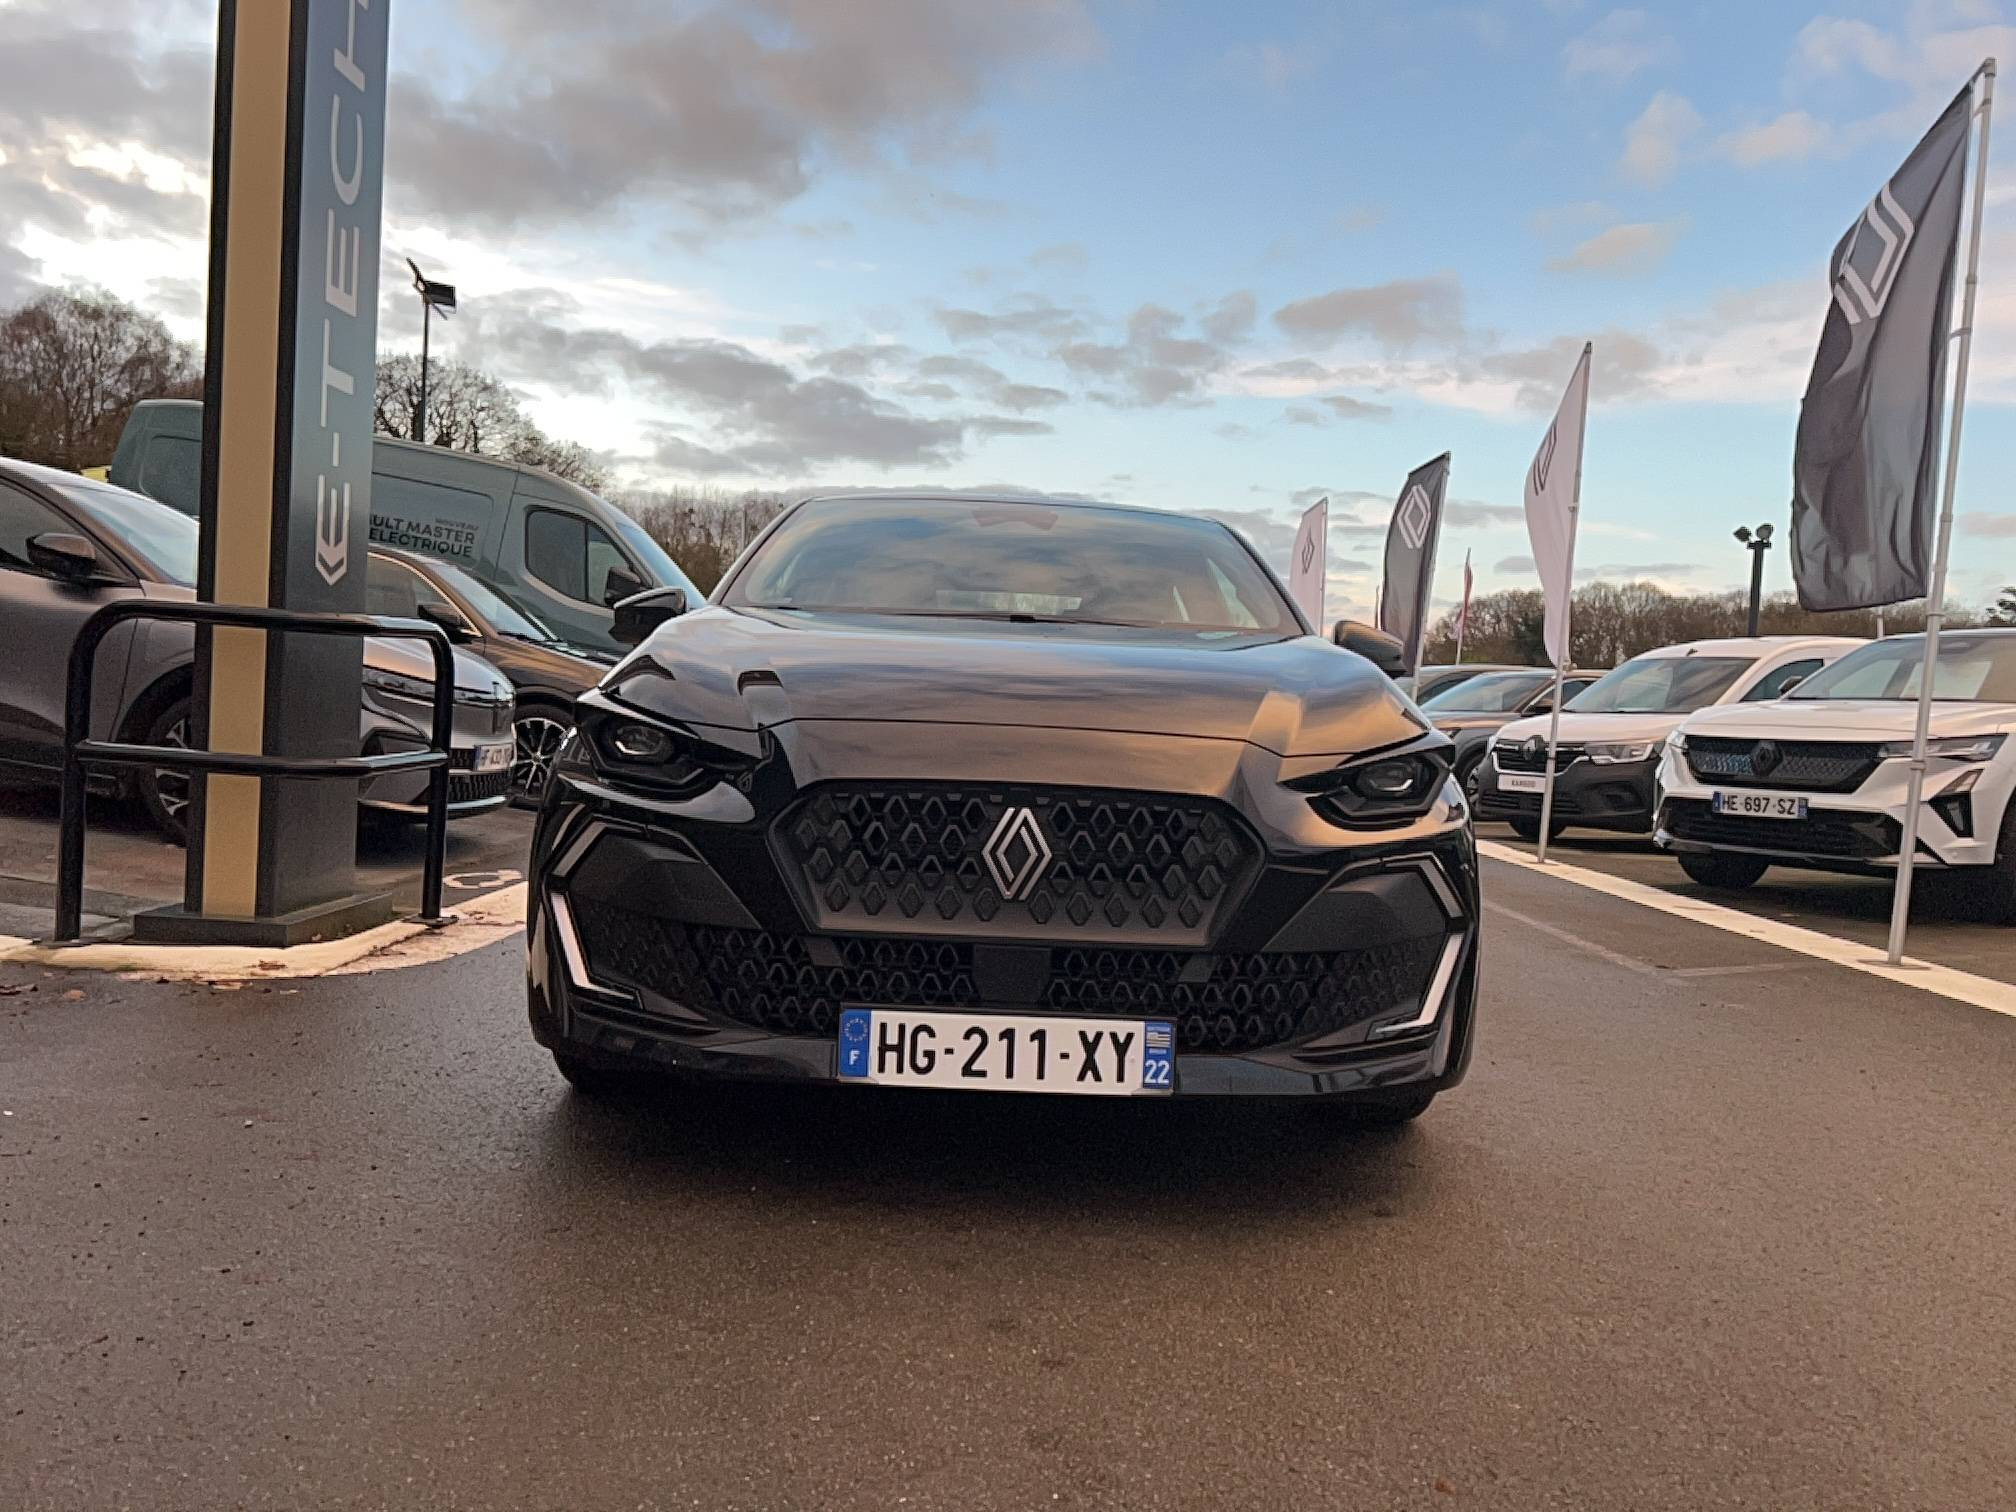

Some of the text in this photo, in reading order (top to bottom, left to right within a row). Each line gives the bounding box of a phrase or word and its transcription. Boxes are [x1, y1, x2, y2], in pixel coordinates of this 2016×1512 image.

[369, 527, 473, 557] ELECTRIQUE
[405, 520, 476, 545] MASTER
[849, 1022, 1170, 1084] F HG-211-XY 22
